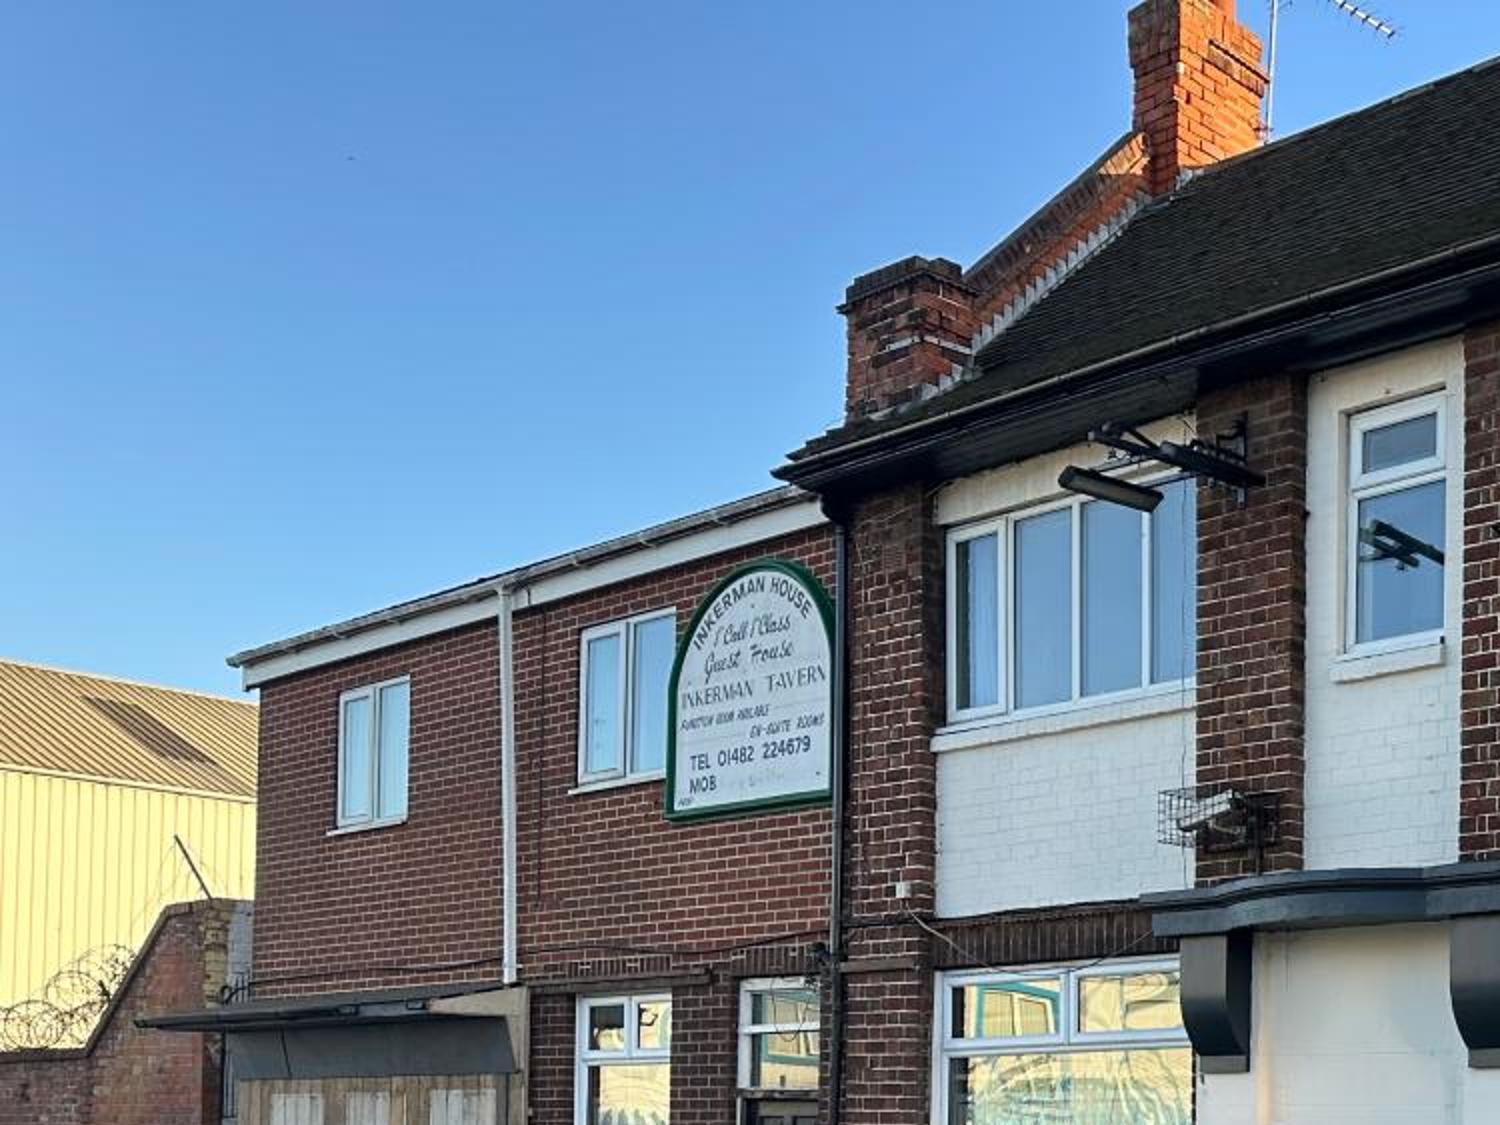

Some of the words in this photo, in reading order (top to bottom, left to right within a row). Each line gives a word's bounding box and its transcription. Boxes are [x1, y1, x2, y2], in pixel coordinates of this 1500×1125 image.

[693, 576, 767, 651] INKERMAN
[769, 577, 813, 619] HOUSE
[681, 679, 753, 710] INKERMAN
[766, 663, 826, 693] TAVERN
[689, 753, 711, 772] TEL
[717, 745, 755, 768] 01482
[690, 774, 717, 794] MOB
